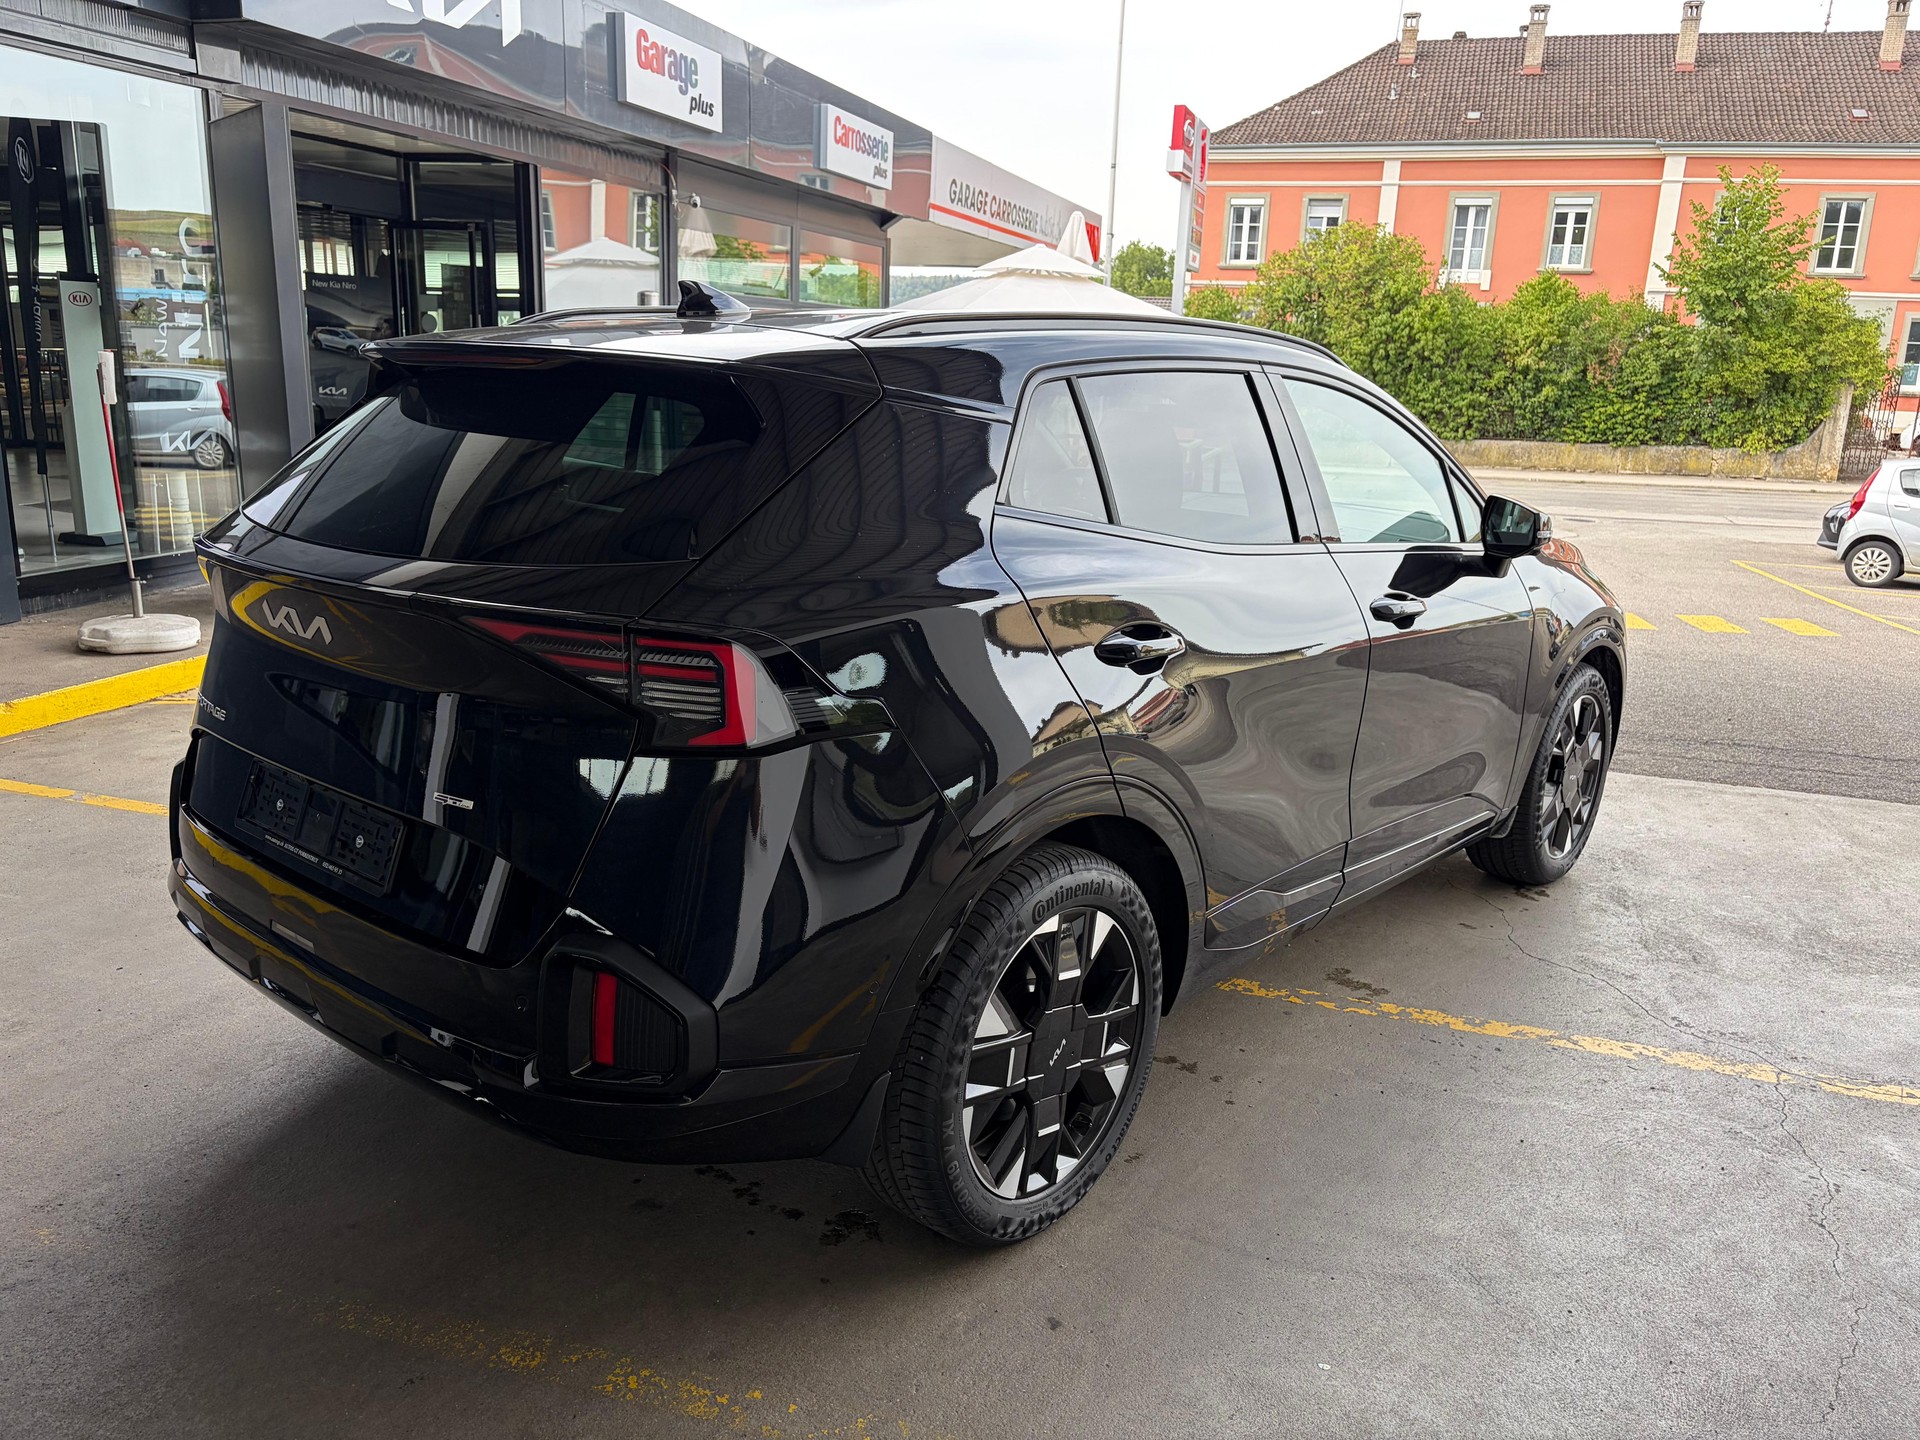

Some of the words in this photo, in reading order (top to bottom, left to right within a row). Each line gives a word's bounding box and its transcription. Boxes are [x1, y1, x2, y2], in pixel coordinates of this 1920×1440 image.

[636, 28, 699, 95] Garage
[689, 93, 715, 117] plus
[833, 115, 889, 163] Carrosserie
[873, 163, 888, 180] plus
[949, 178, 989, 215] GARAGE
[989, 194, 1039, 234] CARROSSERIE
[72, 294, 90, 304] KIA
[312, 279, 328, 288] New
[329, 280, 341, 289] Kia
[342, 281, 357, 290] Niro
[261, 599, 334, 646] KIA
[1031, 878, 1106, 925] Continental
